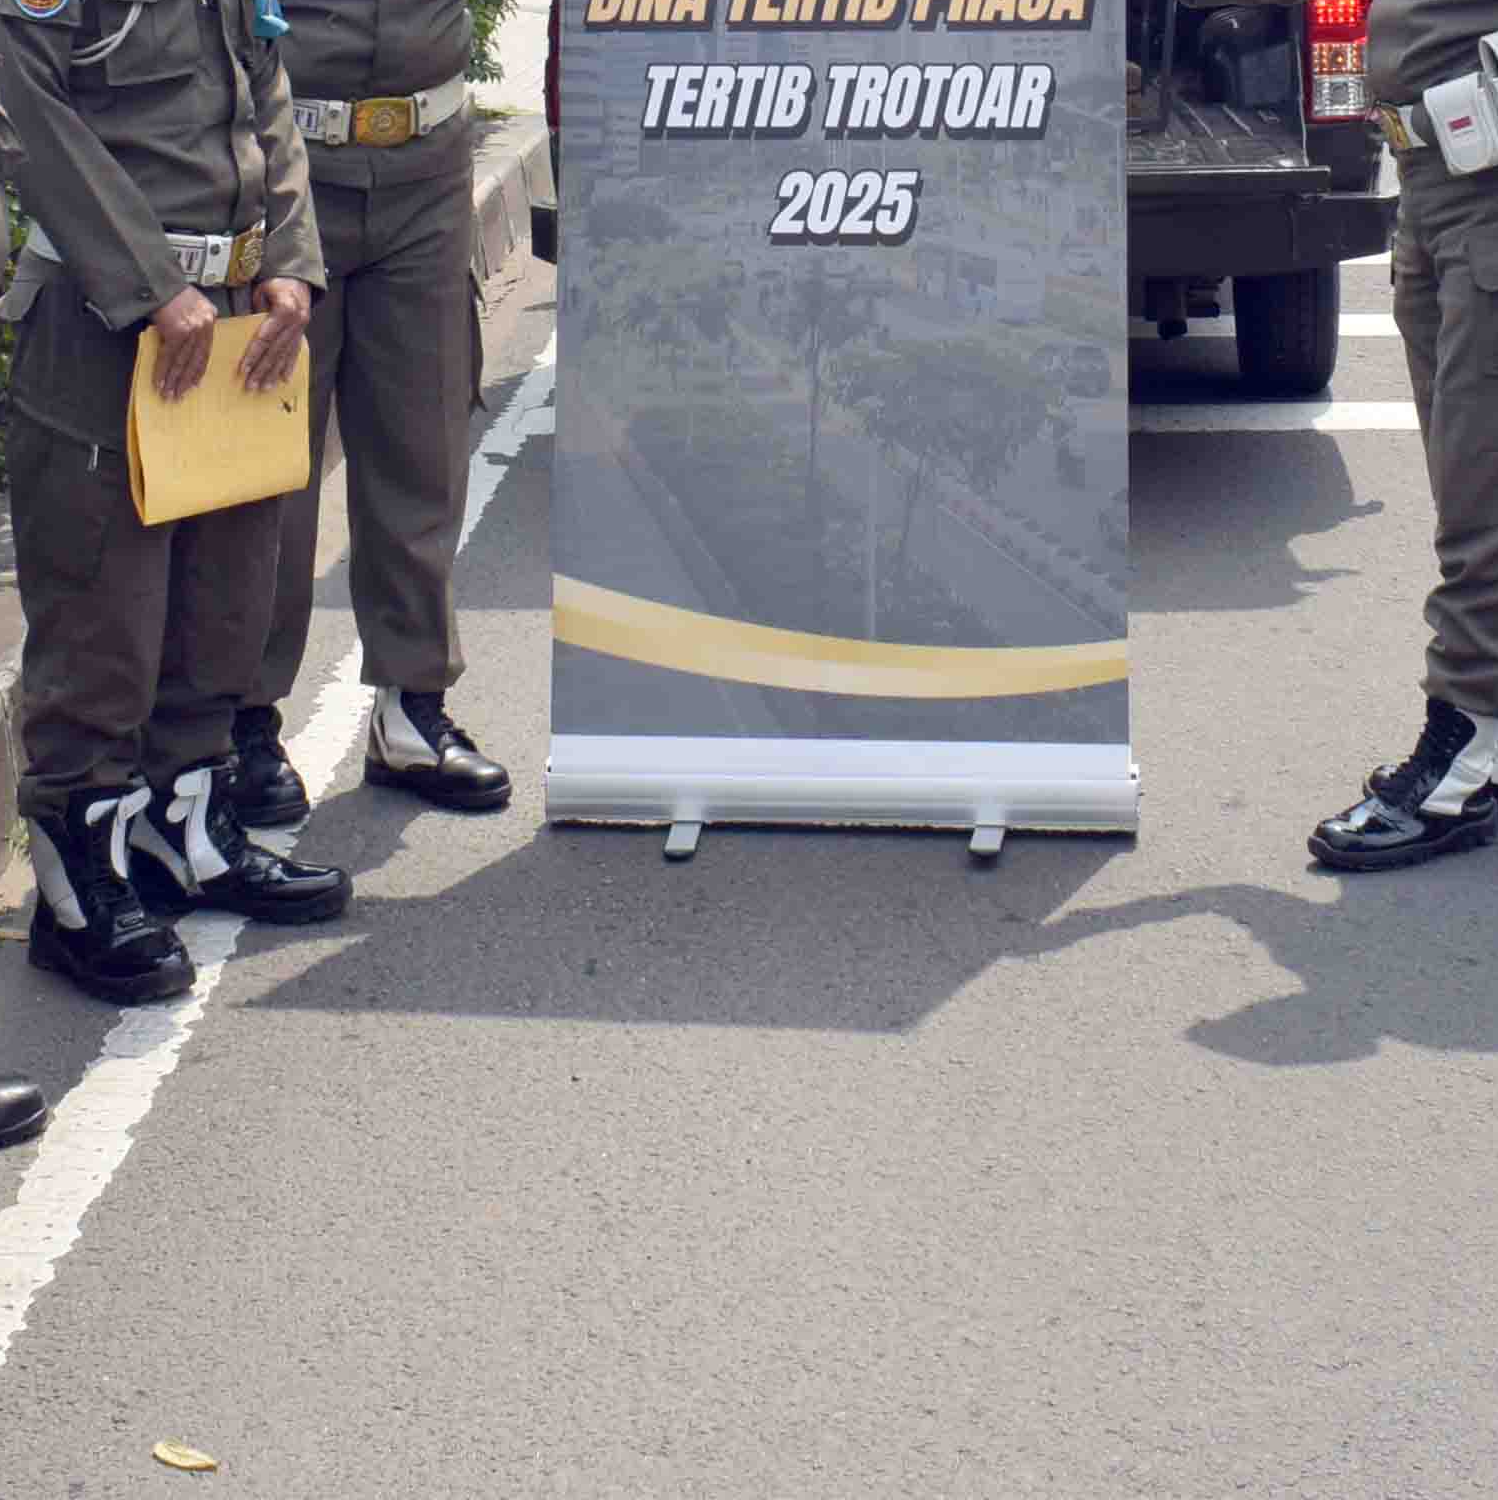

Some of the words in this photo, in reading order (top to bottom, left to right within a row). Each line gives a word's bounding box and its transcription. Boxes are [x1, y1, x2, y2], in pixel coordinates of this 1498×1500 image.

[641, 63, 815, 130] TERTIB
[823, 63, 1054, 130] TROTOAR
[768, 170, 921, 236] 2025
